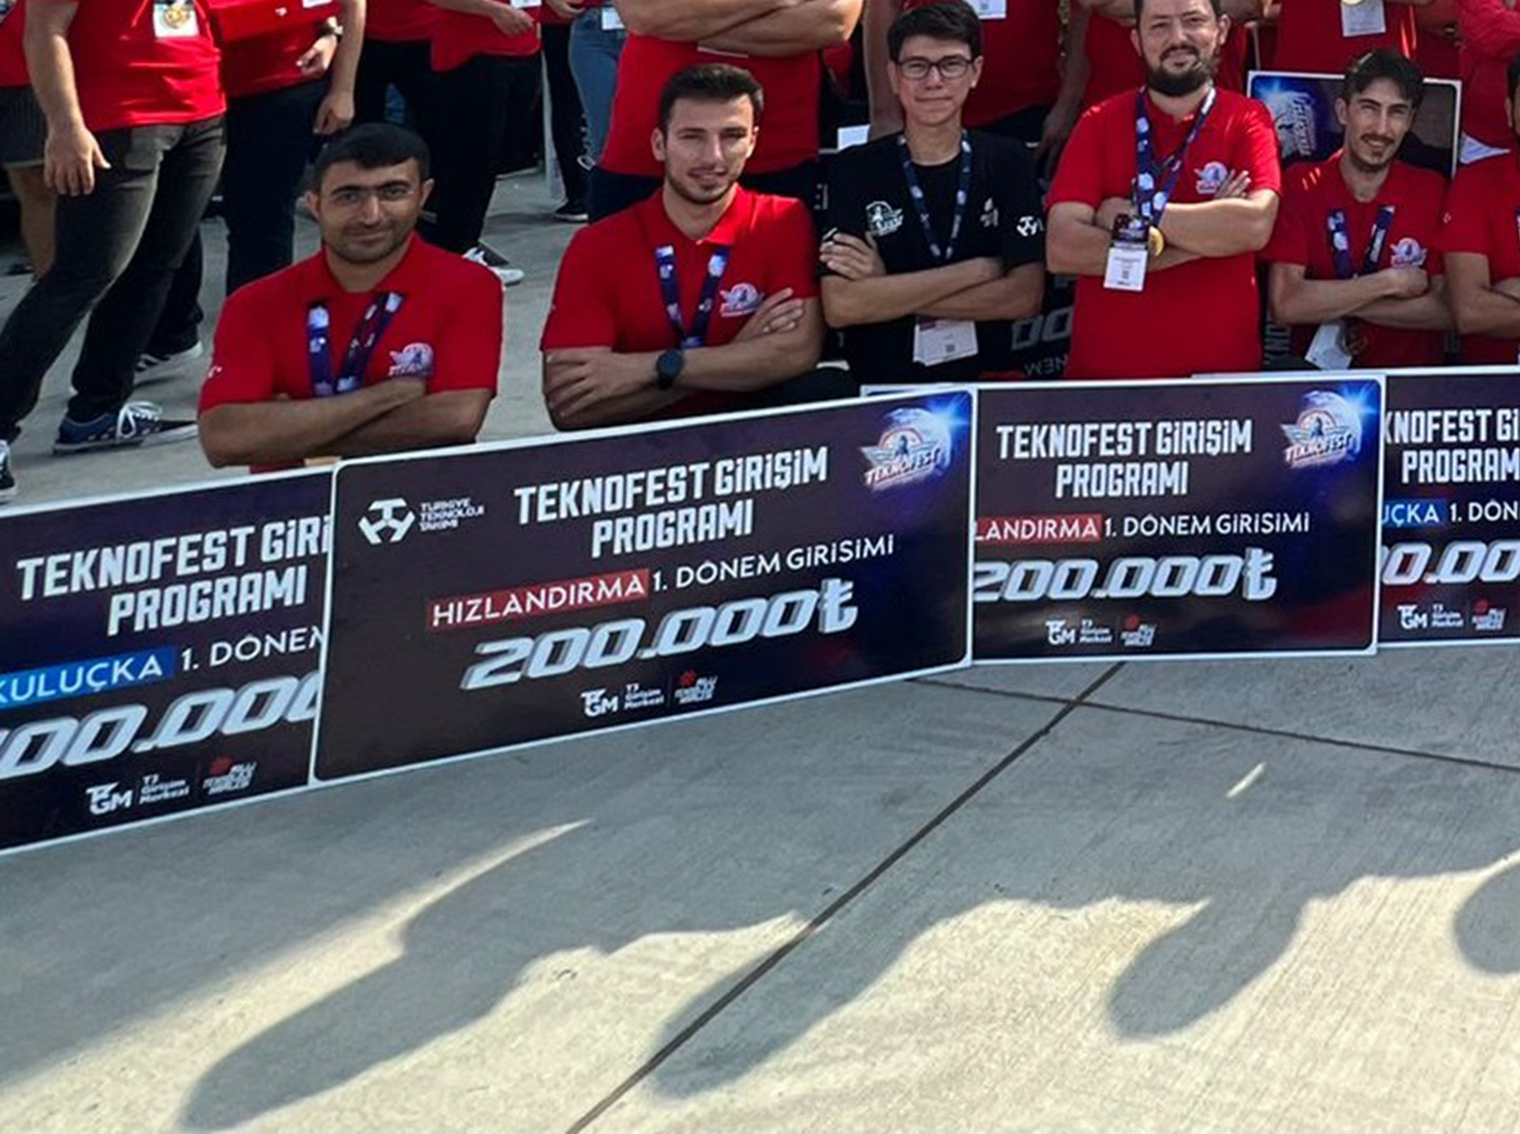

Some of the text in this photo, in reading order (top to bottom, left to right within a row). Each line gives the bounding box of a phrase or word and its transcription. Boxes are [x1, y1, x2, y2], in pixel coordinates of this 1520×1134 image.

[996, 422, 1152, 459] TEKNOFEST
[514, 464, 709, 525] TEKNOFEST
[1055, 461, 1188, 498] PROGRAMI
[592, 498, 753, 558] PROGRAMI
[1105, 521, 1117, 538] 1.
[1450, 502, 1463, 522] 1.
[17, 526, 255, 601] TEKNOFEST
[107, 565, 307, 636] PROGRAMI
[433, 574, 644, 626] HIZLANDIRMA
[652, 570, 668, 592] 1.
[181, 648, 199, 672] 1.
[0, 671, 322, 780] 00.00
